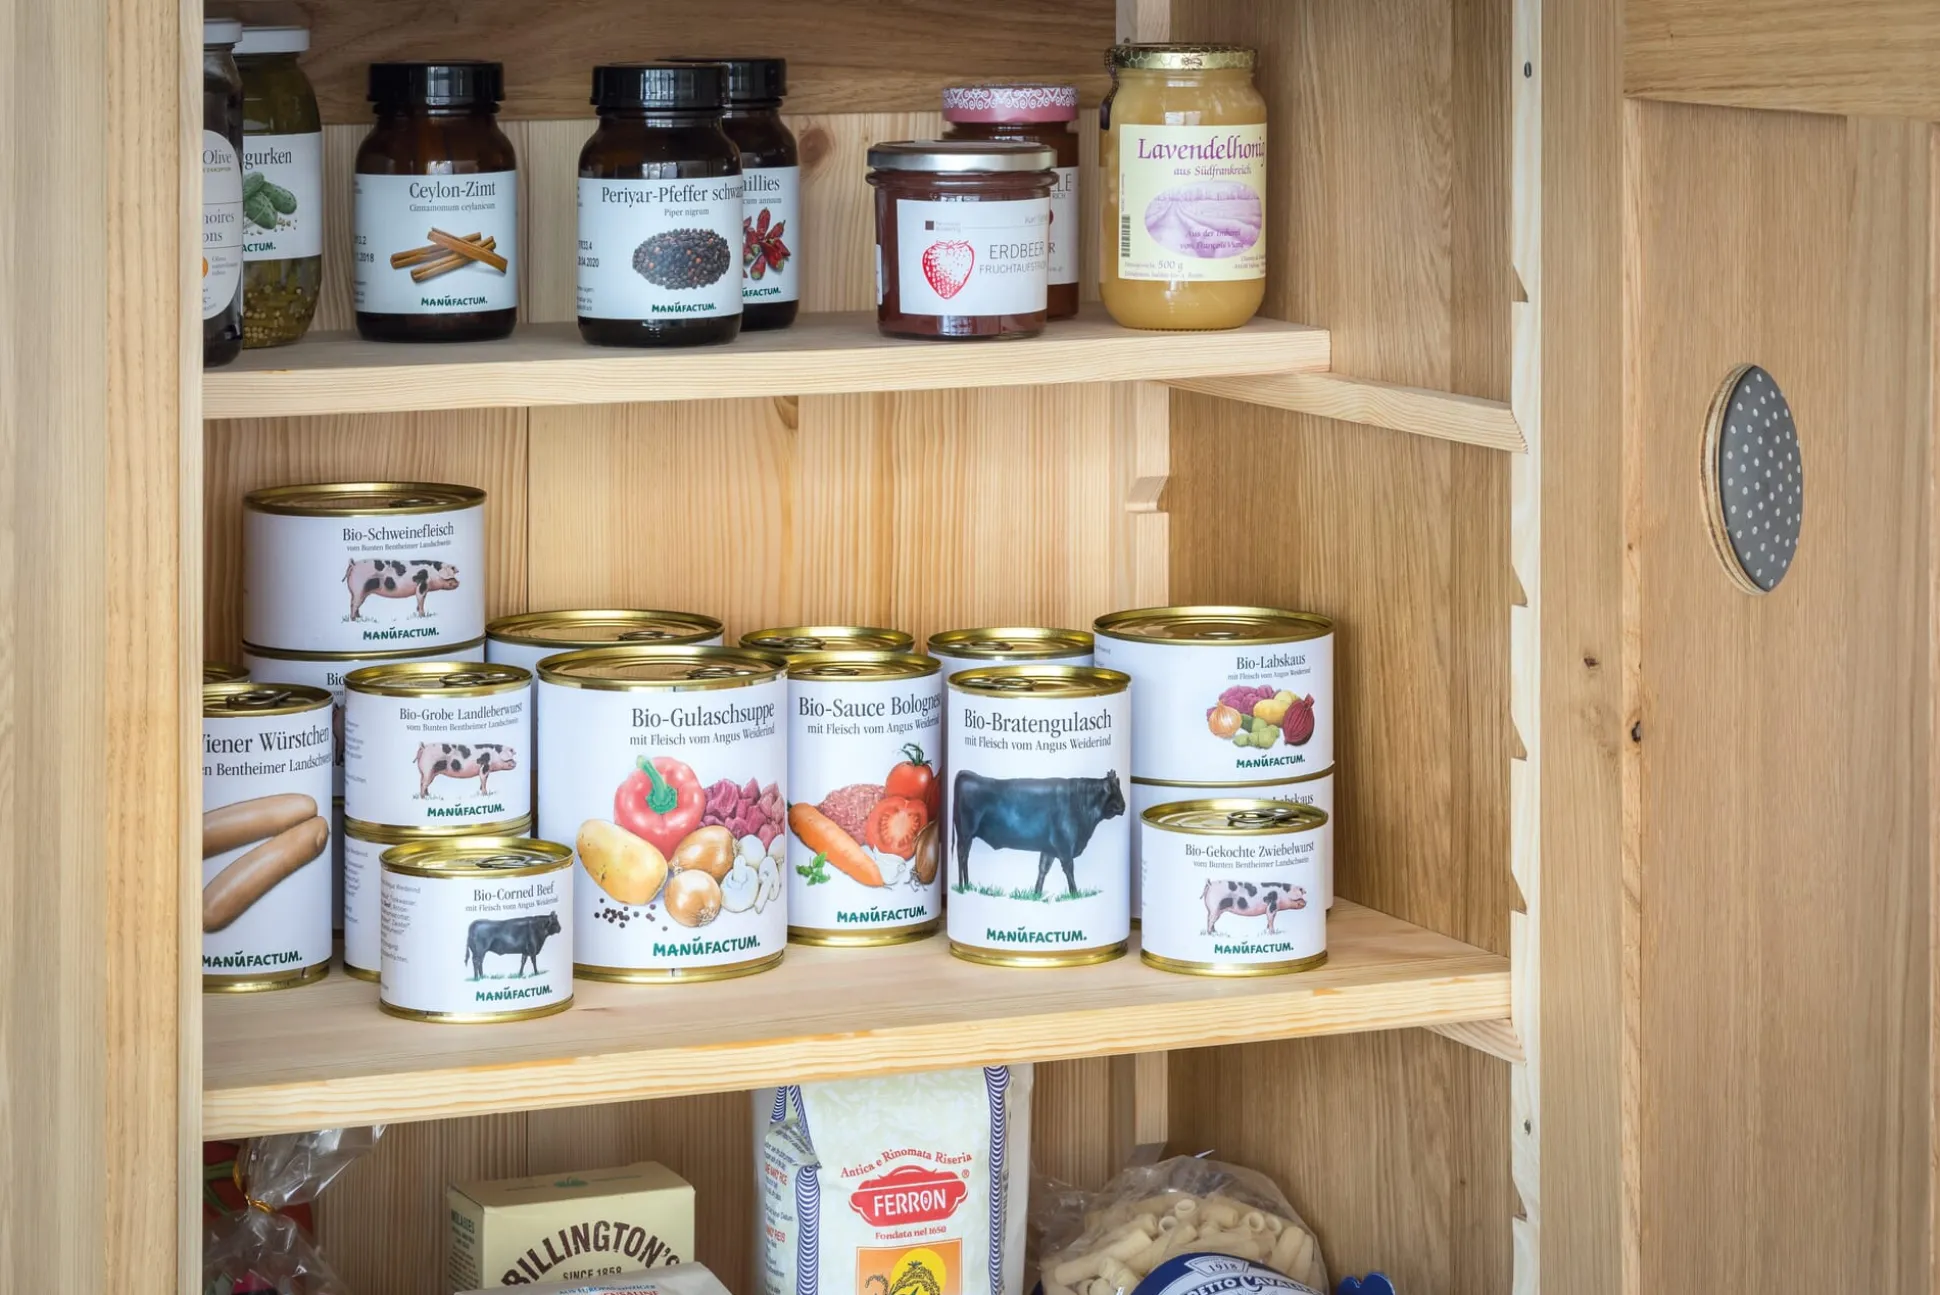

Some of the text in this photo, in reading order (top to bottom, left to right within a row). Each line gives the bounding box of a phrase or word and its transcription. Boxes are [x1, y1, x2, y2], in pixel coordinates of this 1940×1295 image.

[203, 150, 232, 164] Olive
[1174, 164, 1252, 180] aus Südfrankreich
[409, 181, 496, 202] Ceylon-Zimt
[602, 182, 708, 207] Periyar-Pfeffer
[664, 207, 709, 218] Piper nigrum
[990, 240, 1045, 260] ERDBEER
[1158, 260, 1176, 269] 500
[343, 522, 454, 541] Bio-Schweinefleisch
[362, 544, 384, 552] Bunten
[1236, 653, 1306, 670] Bio-Labskaus
[399, 702, 523, 720] Bio-Grobe Landleberwurst
[632, 702, 774, 728] Bio-Gulaschsuppe
[799, 697, 885, 718] Bio-Sauce
[450, 722, 488, 731] Bentheimer
[808, 724, 823, 734] mit
[826, 724, 860, 734] Fleisch
[864, 726, 884, 734] vom
[886, 722, 914, 734] Angus
[964, 708, 1112, 738] Bio-Bratengulasch
[203, 725, 330, 754] iener Würstchen
[630, 722, 774, 746] mit Fleisch vom Angus Weiderind
[964, 734, 1112, 753] mit Fleisch vom Angus Weiderind
[216, 760, 286, 776] Bentheimer
[1185, 841, 1314, 858] Bio-Gekochte Zwiebelwurst
[1193, 860, 1208, 868] vom
[1236, 860, 1274, 868] Bentheimer
[474, 880, 555, 901] Bio-Corned Beef
[480, 904, 502, 912] Fleisch
[518, 901, 535, 910] Angus
[841, 1164, 875, 1178] Antica
[882, 1148, 932, 1162] Rinomata
[935, 1152, 972, 1164] Riseria
[874, 1188, 946, 1217] FERRON
[875, 1228, 912, 1240] Fondata
[914, 1227, 928, 1236] nel
[562, 1269, 594, 1280] SINCE
[1209, 1262, 1238, 1272] 1918
